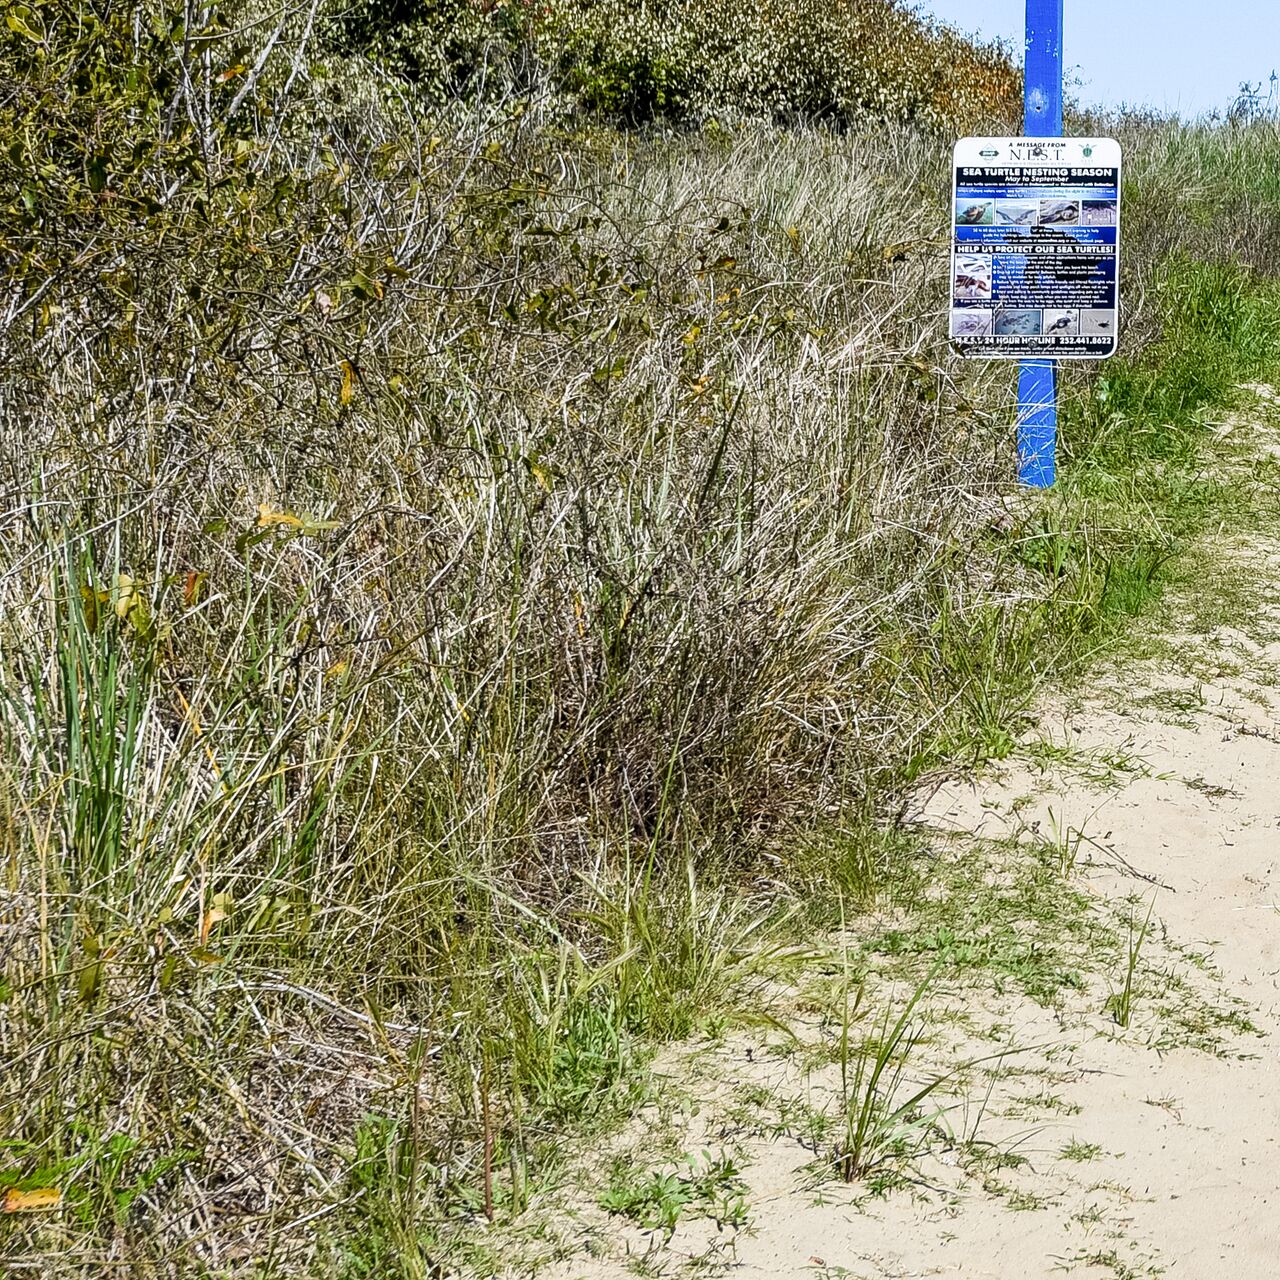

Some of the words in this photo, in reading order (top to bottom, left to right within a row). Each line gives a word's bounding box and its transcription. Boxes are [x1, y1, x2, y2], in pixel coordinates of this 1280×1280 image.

[963, 168, 982, 176] SEA
[985, 168, 1020, 176] TURTLE
[958, 245, 979, 253] HELP
[982, 245, 993, 253] US
[995, 245, 1033, 253] PROTECT
[1035, 245, 1055, 253] OUR
[1057, 245, 1073, 253] SEA
[1075, 245, 1113, 253] TURTLES!
